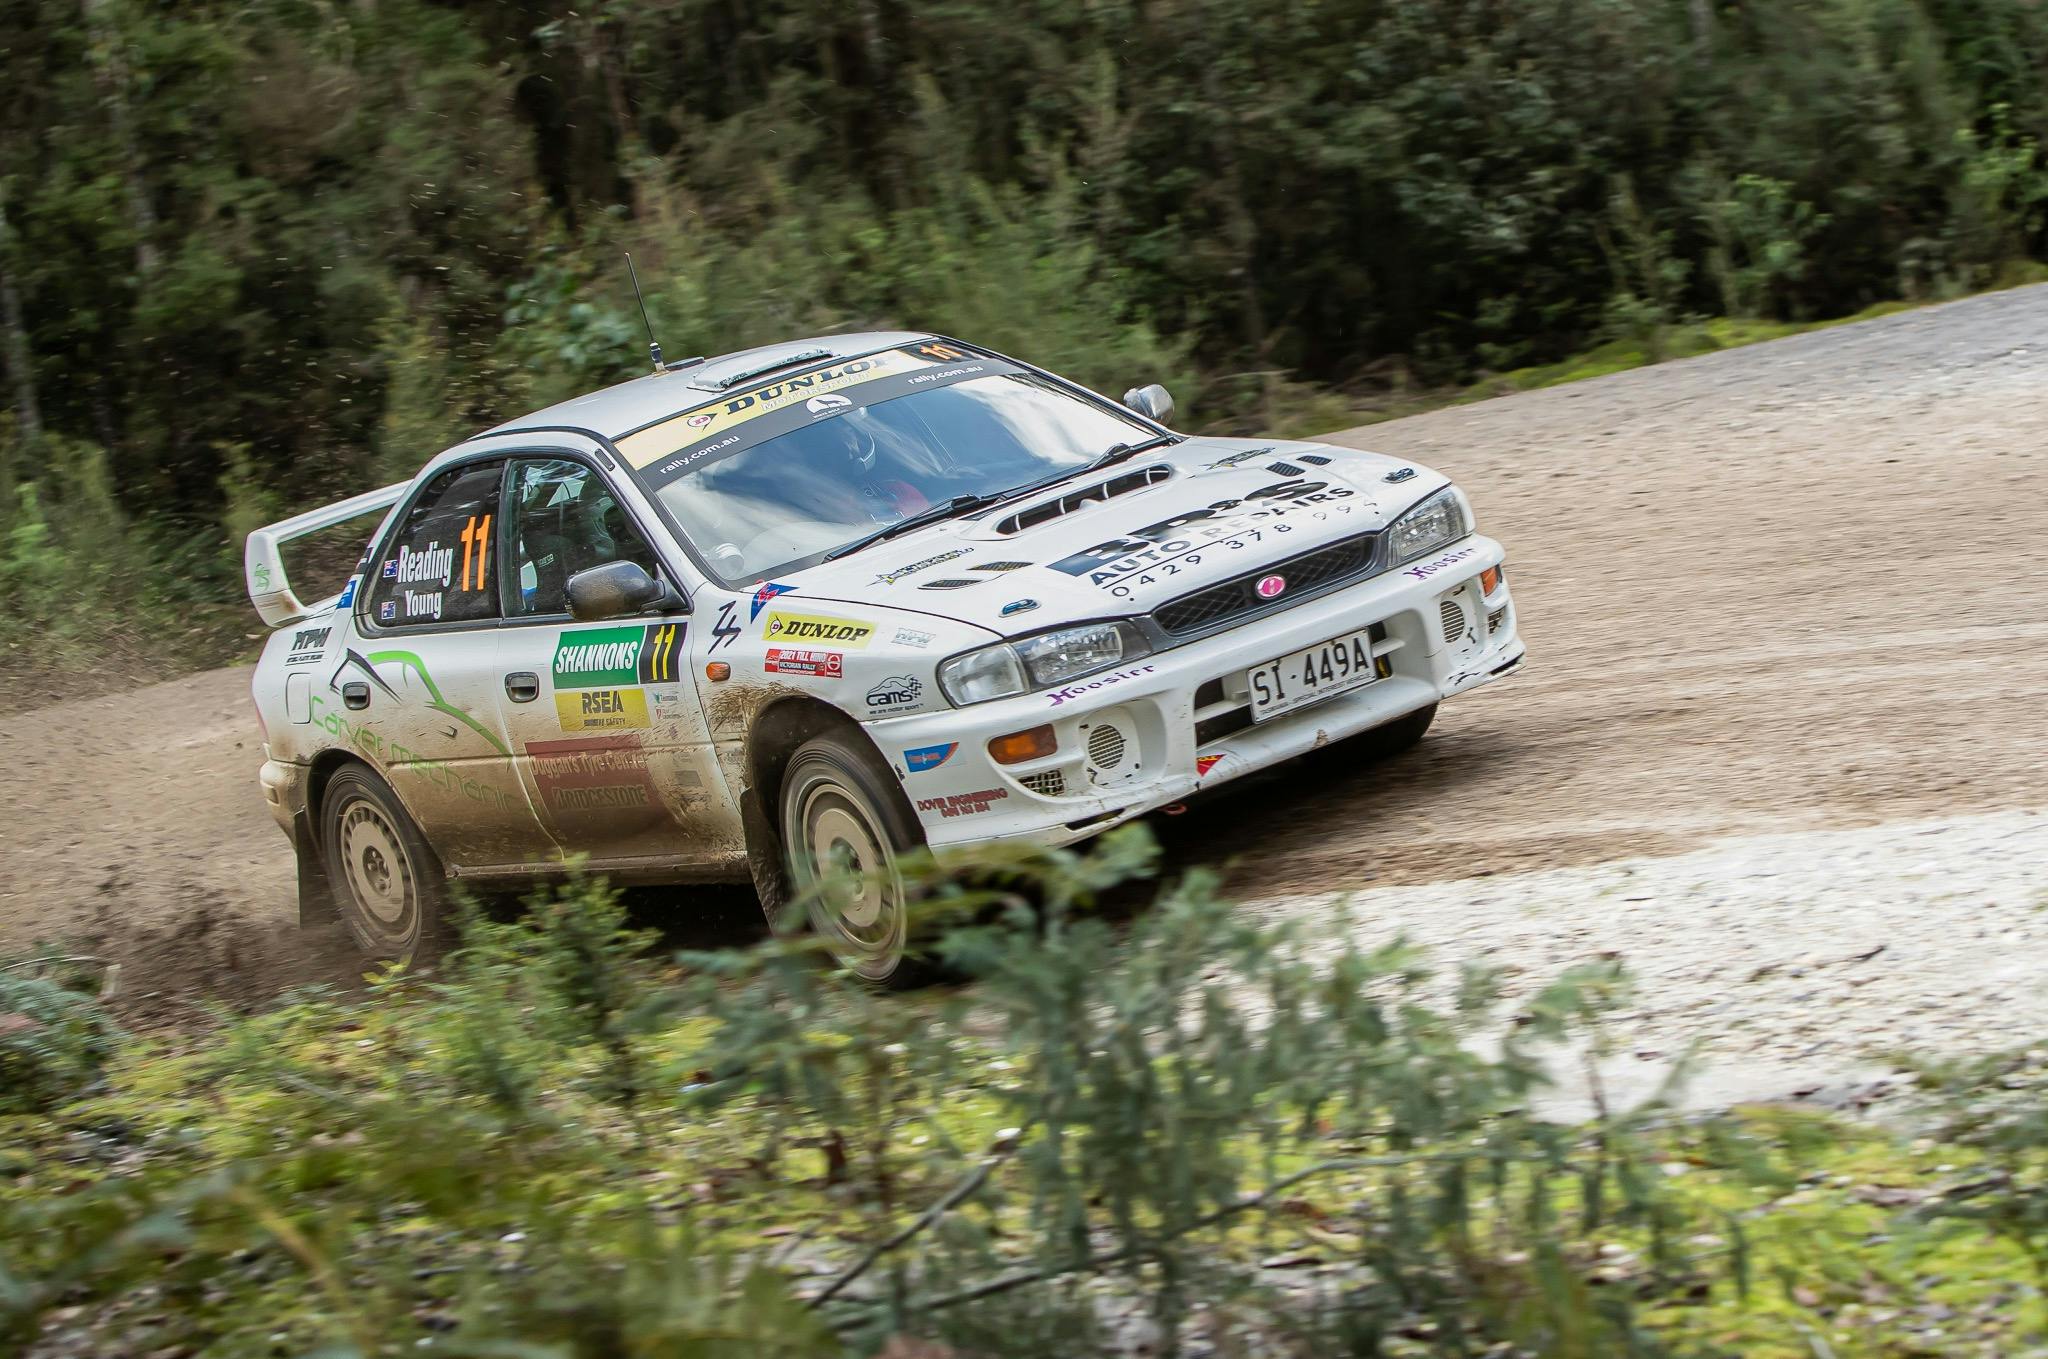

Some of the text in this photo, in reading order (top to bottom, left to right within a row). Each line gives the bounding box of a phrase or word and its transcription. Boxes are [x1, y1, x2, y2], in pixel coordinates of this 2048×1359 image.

[908, 366, 984, 384] rally.com.au
[660, 436, 740, 473] rally.com.au
[397, 541, 453, 587] Reading
[461, 514, 491, 592] 11
[1090, 540, 1191, 585] AUTO
[405, 590, 442, 619] Young
[784, 620, 869, 641] DUNLOP
[555, 641, 638, 673] SHANNONS
[652, 624, 675, 681] 11
[581, 690, 624, 714] RSEA
[530, 754, 579, 778] Duggan's
[582, 752, 605, 776] Tyre
[555, 786, 646, 809] BRIDGESTONE
